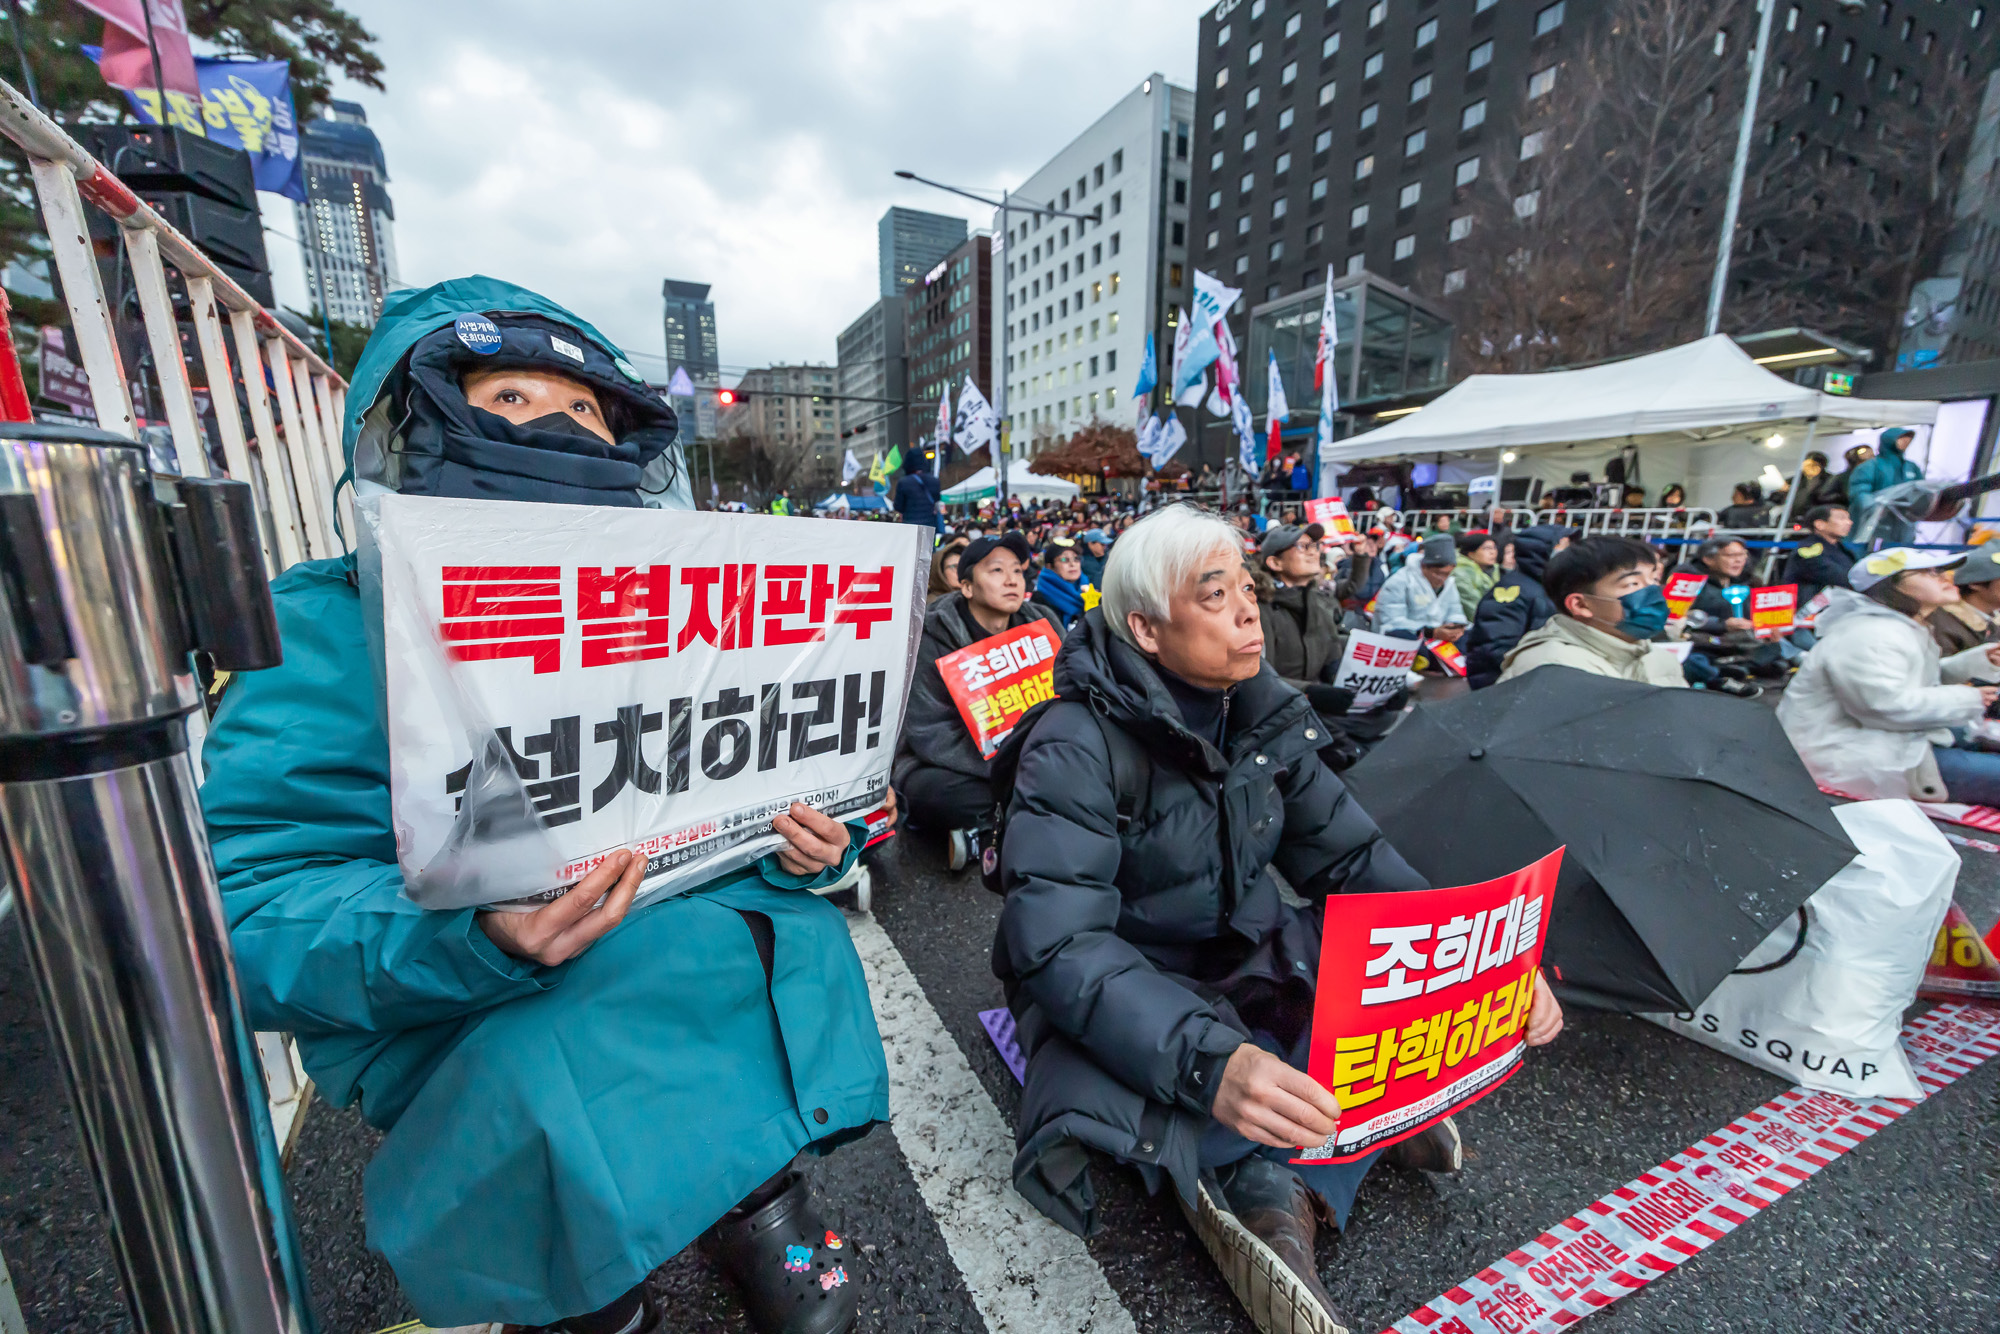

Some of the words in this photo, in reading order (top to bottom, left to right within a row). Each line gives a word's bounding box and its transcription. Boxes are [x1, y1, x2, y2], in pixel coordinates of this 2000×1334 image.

[459, 321, 496, 333] 사법개혁
[440, 563, 895, 674] 특별재판부
[957, 635, 1054, 692] 조희대를
[446, 671, 886, 828] 설치하라!
[804, 789, 839, 807] 모이자!
[1361, 894, 1544, 1006] 조희대를
[1332, 965, 1537, 1110] 탄핵하라!
[1368, 1112, 1401, 1131] 내란청산!
[1475, 1282, 1548, 1334] 危險
[1527, 1228, 1631, 1303] 안전제일
[1616, 1176, 1713, 1244] DANGER!
[1716, 1141, 1775, 1175] 위험
[1751, 1121, 1809, 1155] 危險
